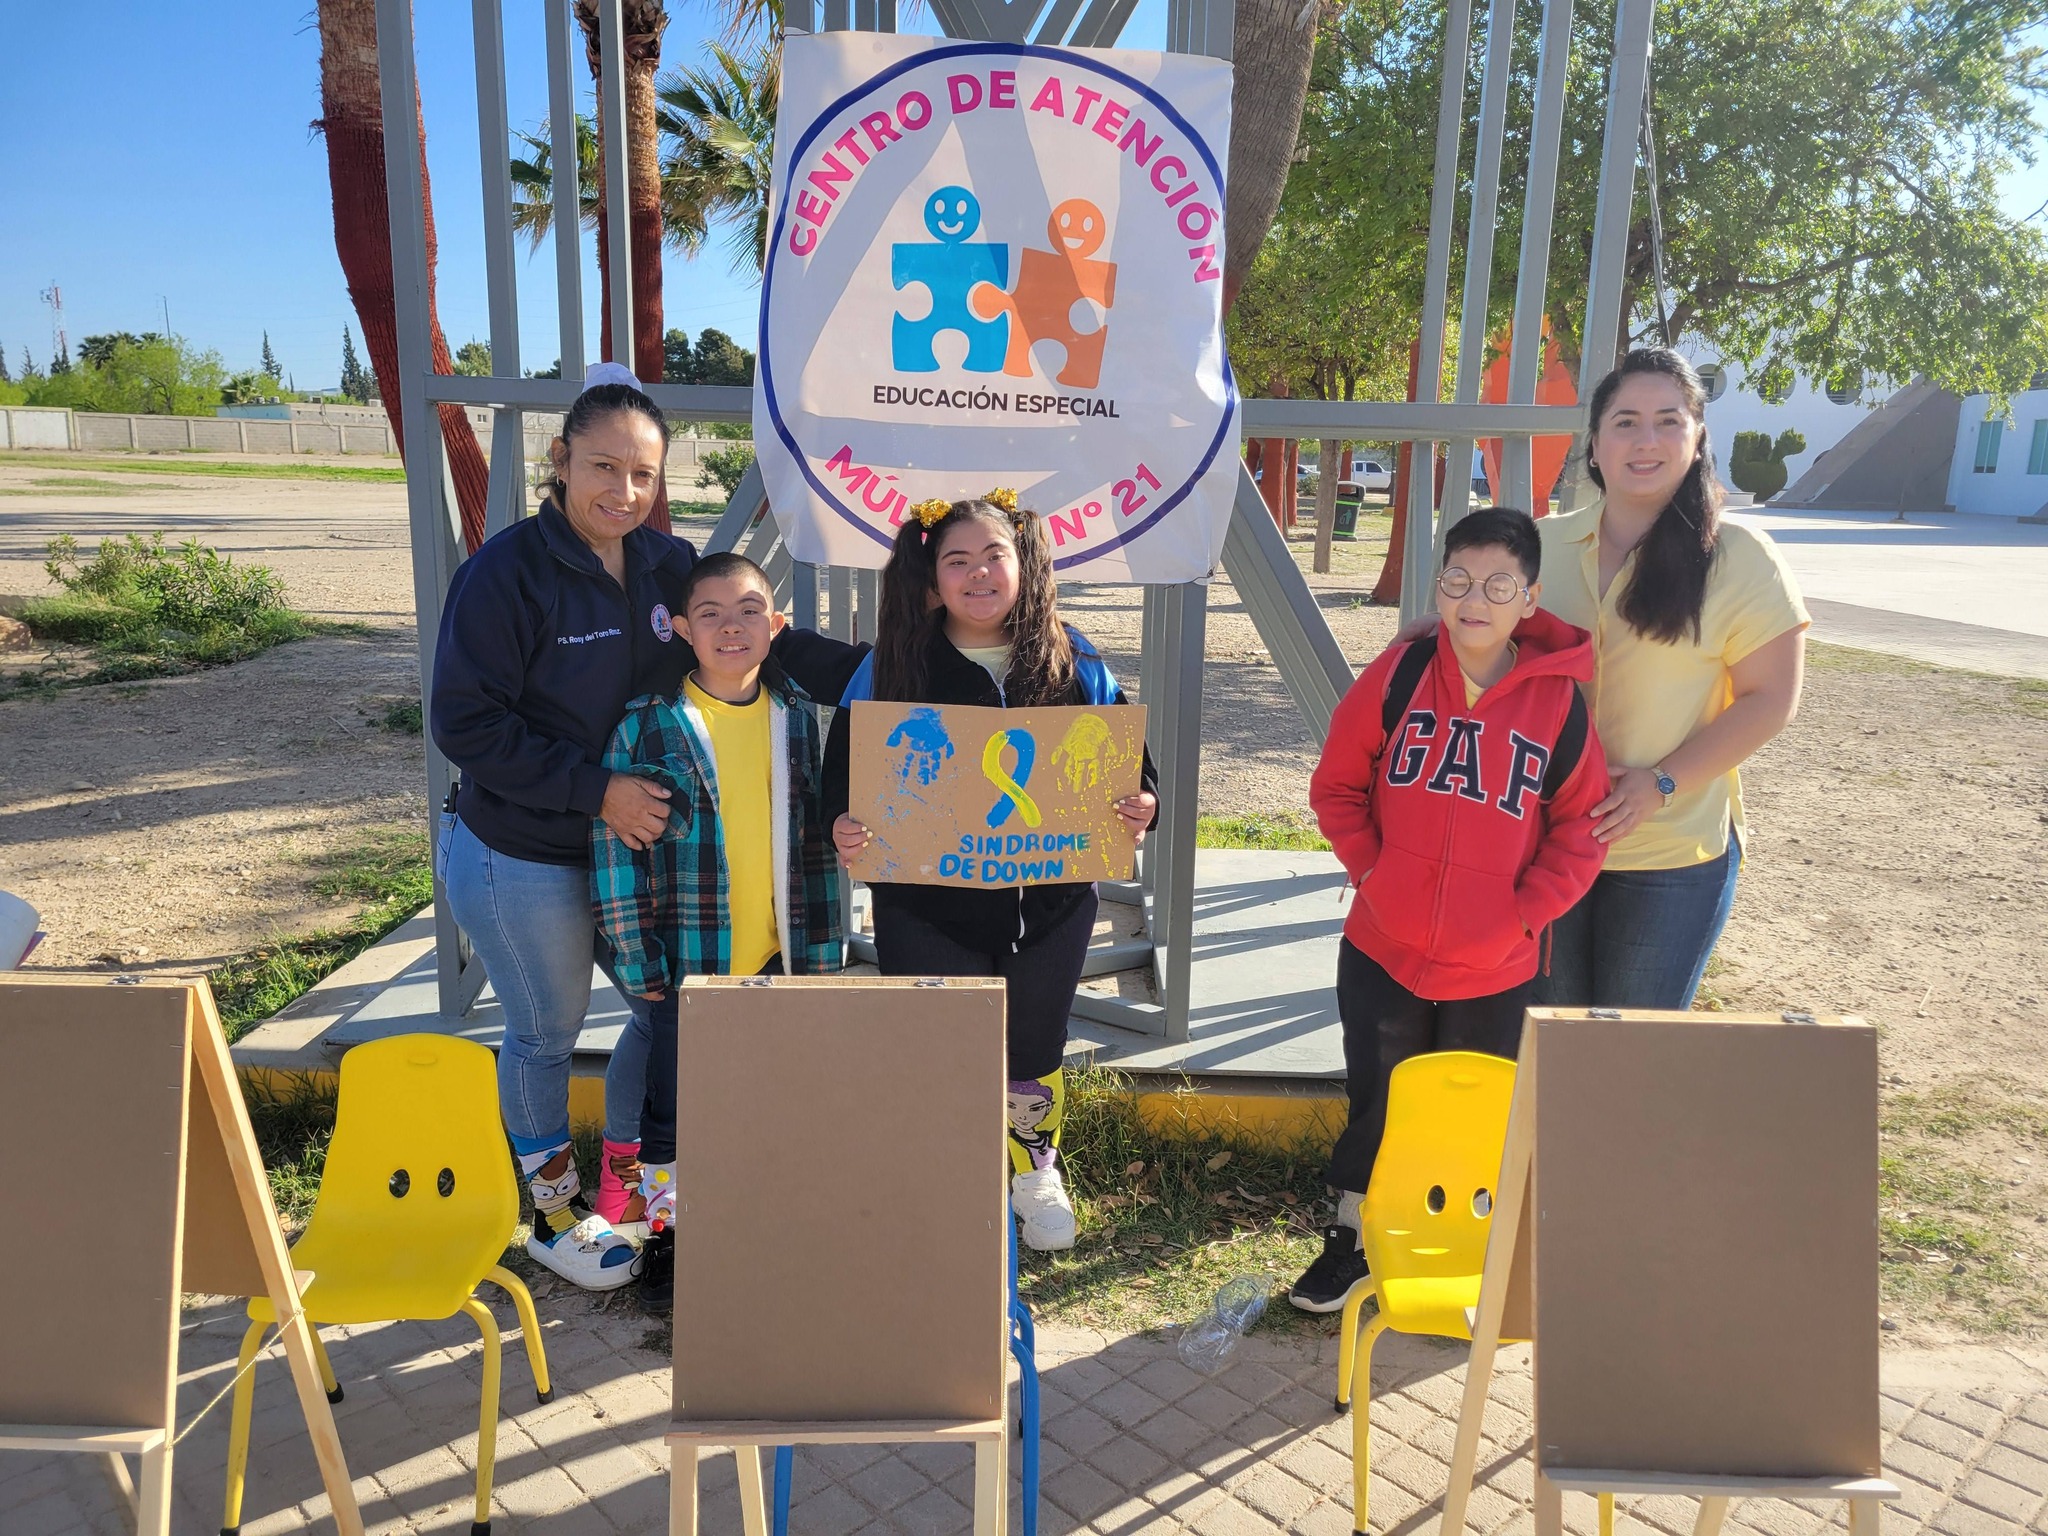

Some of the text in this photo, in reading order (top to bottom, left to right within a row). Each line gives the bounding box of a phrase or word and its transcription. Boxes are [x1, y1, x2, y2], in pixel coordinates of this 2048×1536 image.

[788, 70, 1221, 284] CENTRO DE ATENCIÓN
[873, 384, 1120, 419] EDUCACIÓN ESPECIAL
[1111, 462, 1163, 517] 21
[569, 635, 584, 645] Rosy
[584, 633, 595, 642] del
[594, 631, 609, 639] Toro
[1386, 710, 1550, 820] GAP
[959, 833, 1091, 856] SINDROME
[939, 853, 1064, 883] DE DOWN
